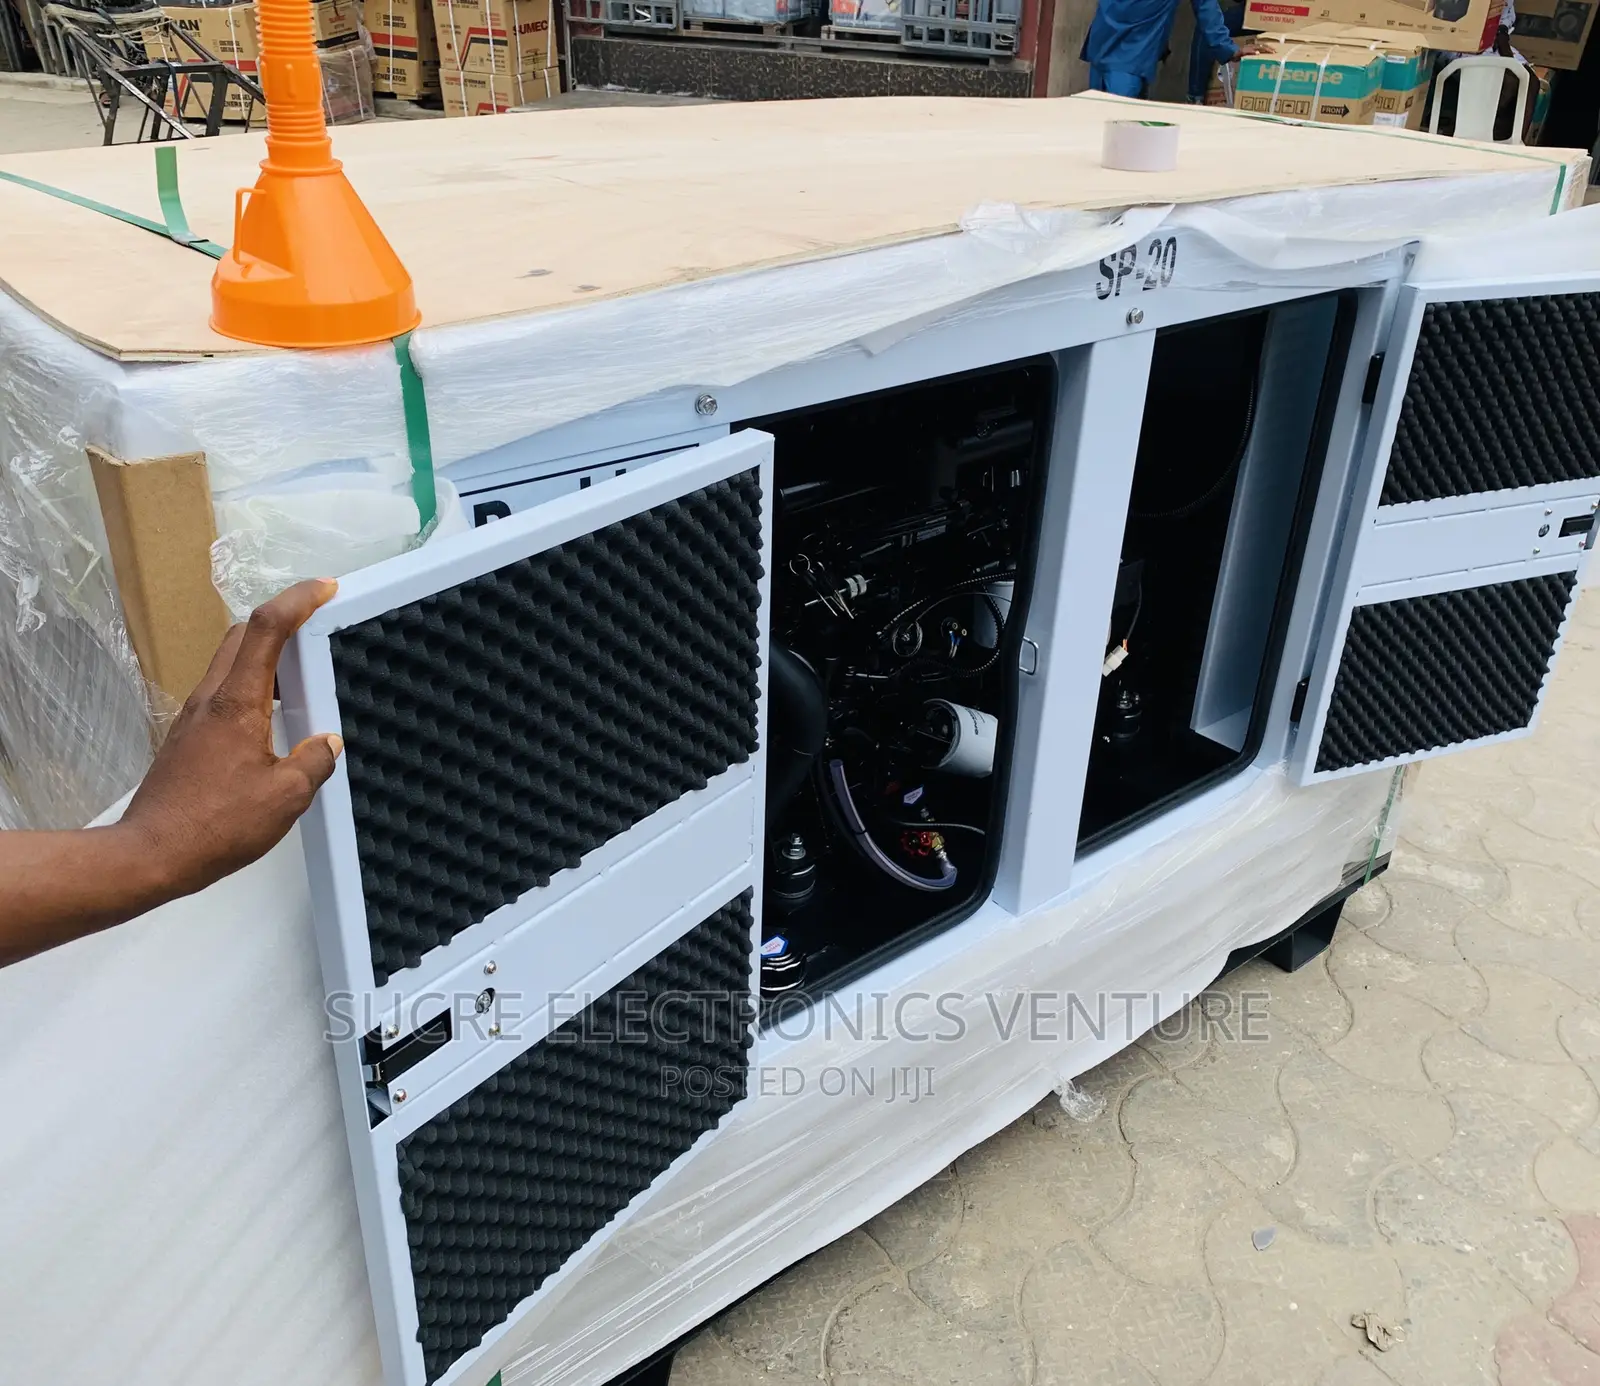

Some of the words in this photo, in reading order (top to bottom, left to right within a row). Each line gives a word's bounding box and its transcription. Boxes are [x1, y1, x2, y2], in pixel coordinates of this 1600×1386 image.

[513, 20, 549, 36] SUMEC
[1258, 64, 1344, 84] Hisense
[1322, 105, 1345, 115] FRONT
[1096, 236, 1177, 300] SP-20
